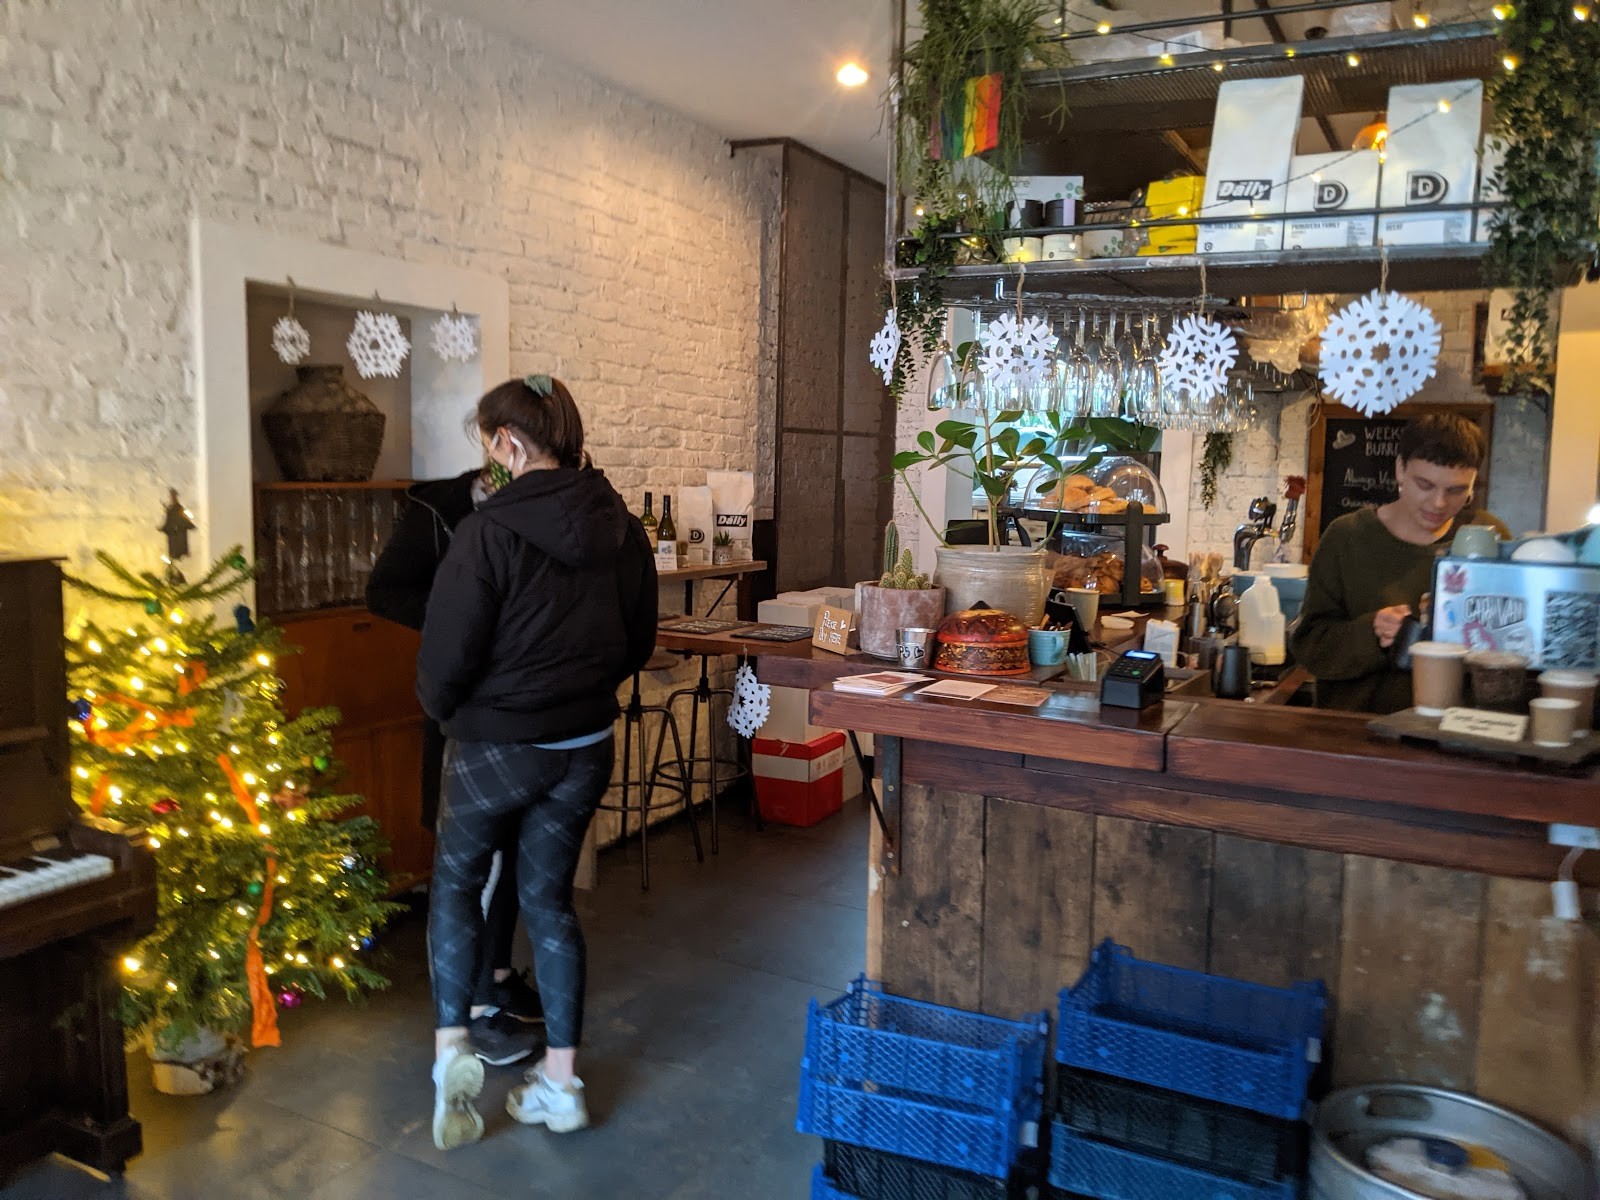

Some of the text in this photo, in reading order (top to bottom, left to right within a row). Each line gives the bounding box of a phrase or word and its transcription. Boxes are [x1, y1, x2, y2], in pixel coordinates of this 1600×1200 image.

[1218, 181, 1270, 200] Daily
[1364, 426, 1404, 441] WEEK
[717, 515, 747, 527] Daily
